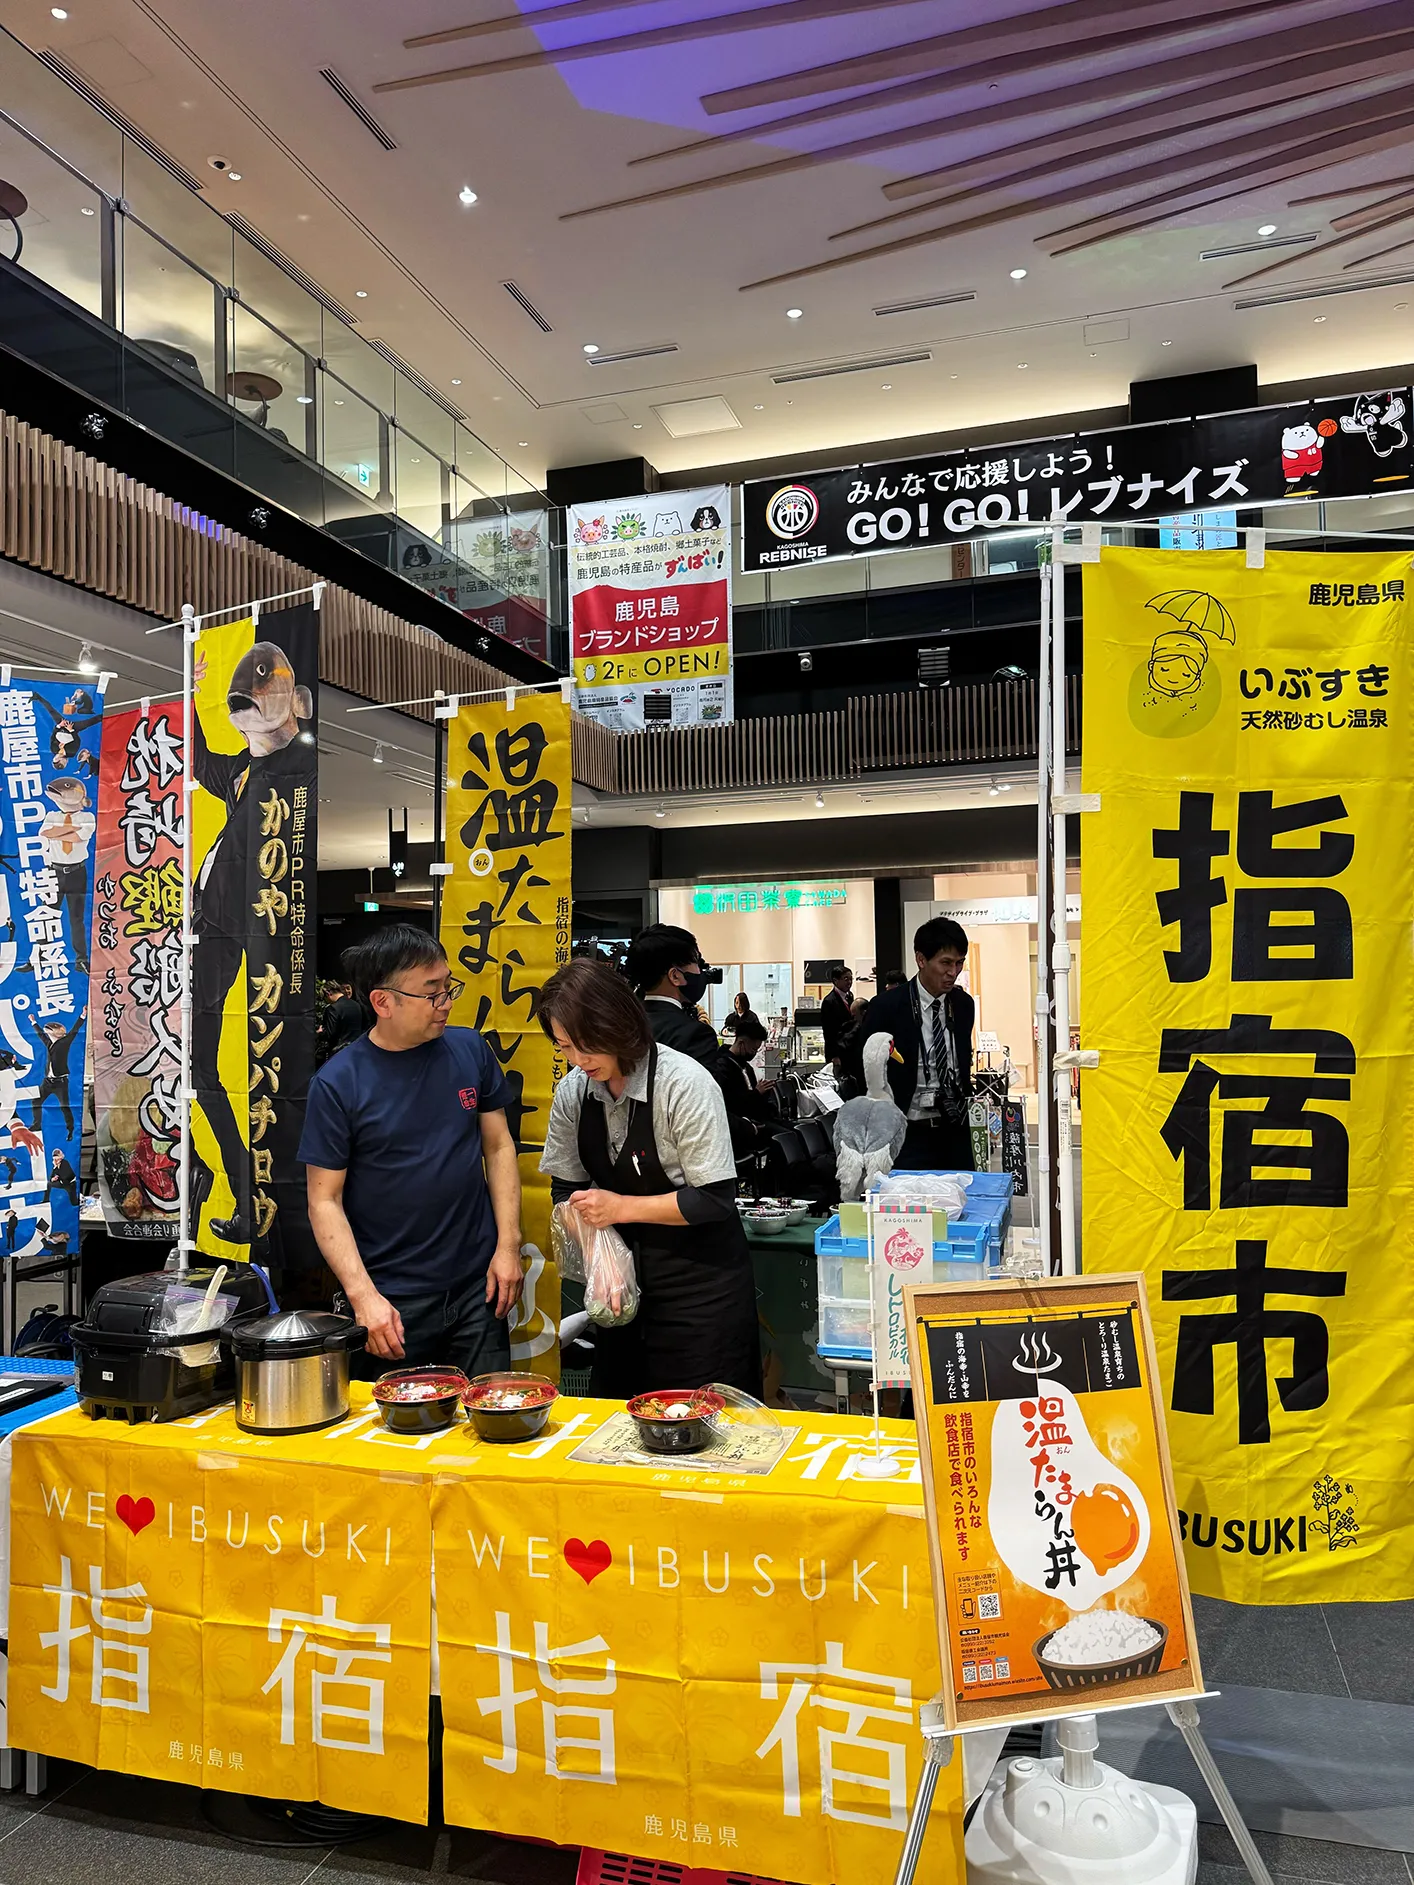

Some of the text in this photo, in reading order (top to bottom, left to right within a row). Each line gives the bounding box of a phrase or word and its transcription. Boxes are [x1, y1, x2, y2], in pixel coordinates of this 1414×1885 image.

[847, 445, 1115, 502] みんなで応援しよう！
[846, 505, 929, 545] GO!
[1050, 459, 1250, 516] レブナイズ
[759, 545, 827, 564] REBNISE
[777, 541, 809, 550] KAGOSHIMA
[576, 561, 662, 580] 鹿児島の特産品が
[615, 595, 680, 623] 鹿児島
[1308, 579, 1405, 607] 鹿児島県
[579, 617, 720, 651] ブランドショップ
[643, 651, 721, 677] OPEN!
[1239, 664, 1390, 702] いぶすき
[1241, 708, 1388, 731] 天然砂むし温泉
[289, 786, 308, 995] 鹿屋市PR特命係長
[250, 787, 290, 1238] かのや カンパチロウ
[1152, 790, 1357, 1445] 指宿市
[945, 1360, 957, 1400] ふんだんに
[1056, 1446, 1071, 1454] おん
[944, 1413, 970, 1561] 飲食店で食べられます
[959, 1412, 982, 1529] 指宿市のいろんな
[40, 1482, 392, 1566] WE IBUSUKI
[467, 1529, 909, 1610] WE IBUSUKI
[167, 1739, 245, 1772] 鹿児島県
[643, 1813, 739, 1849] 鹿児島県
